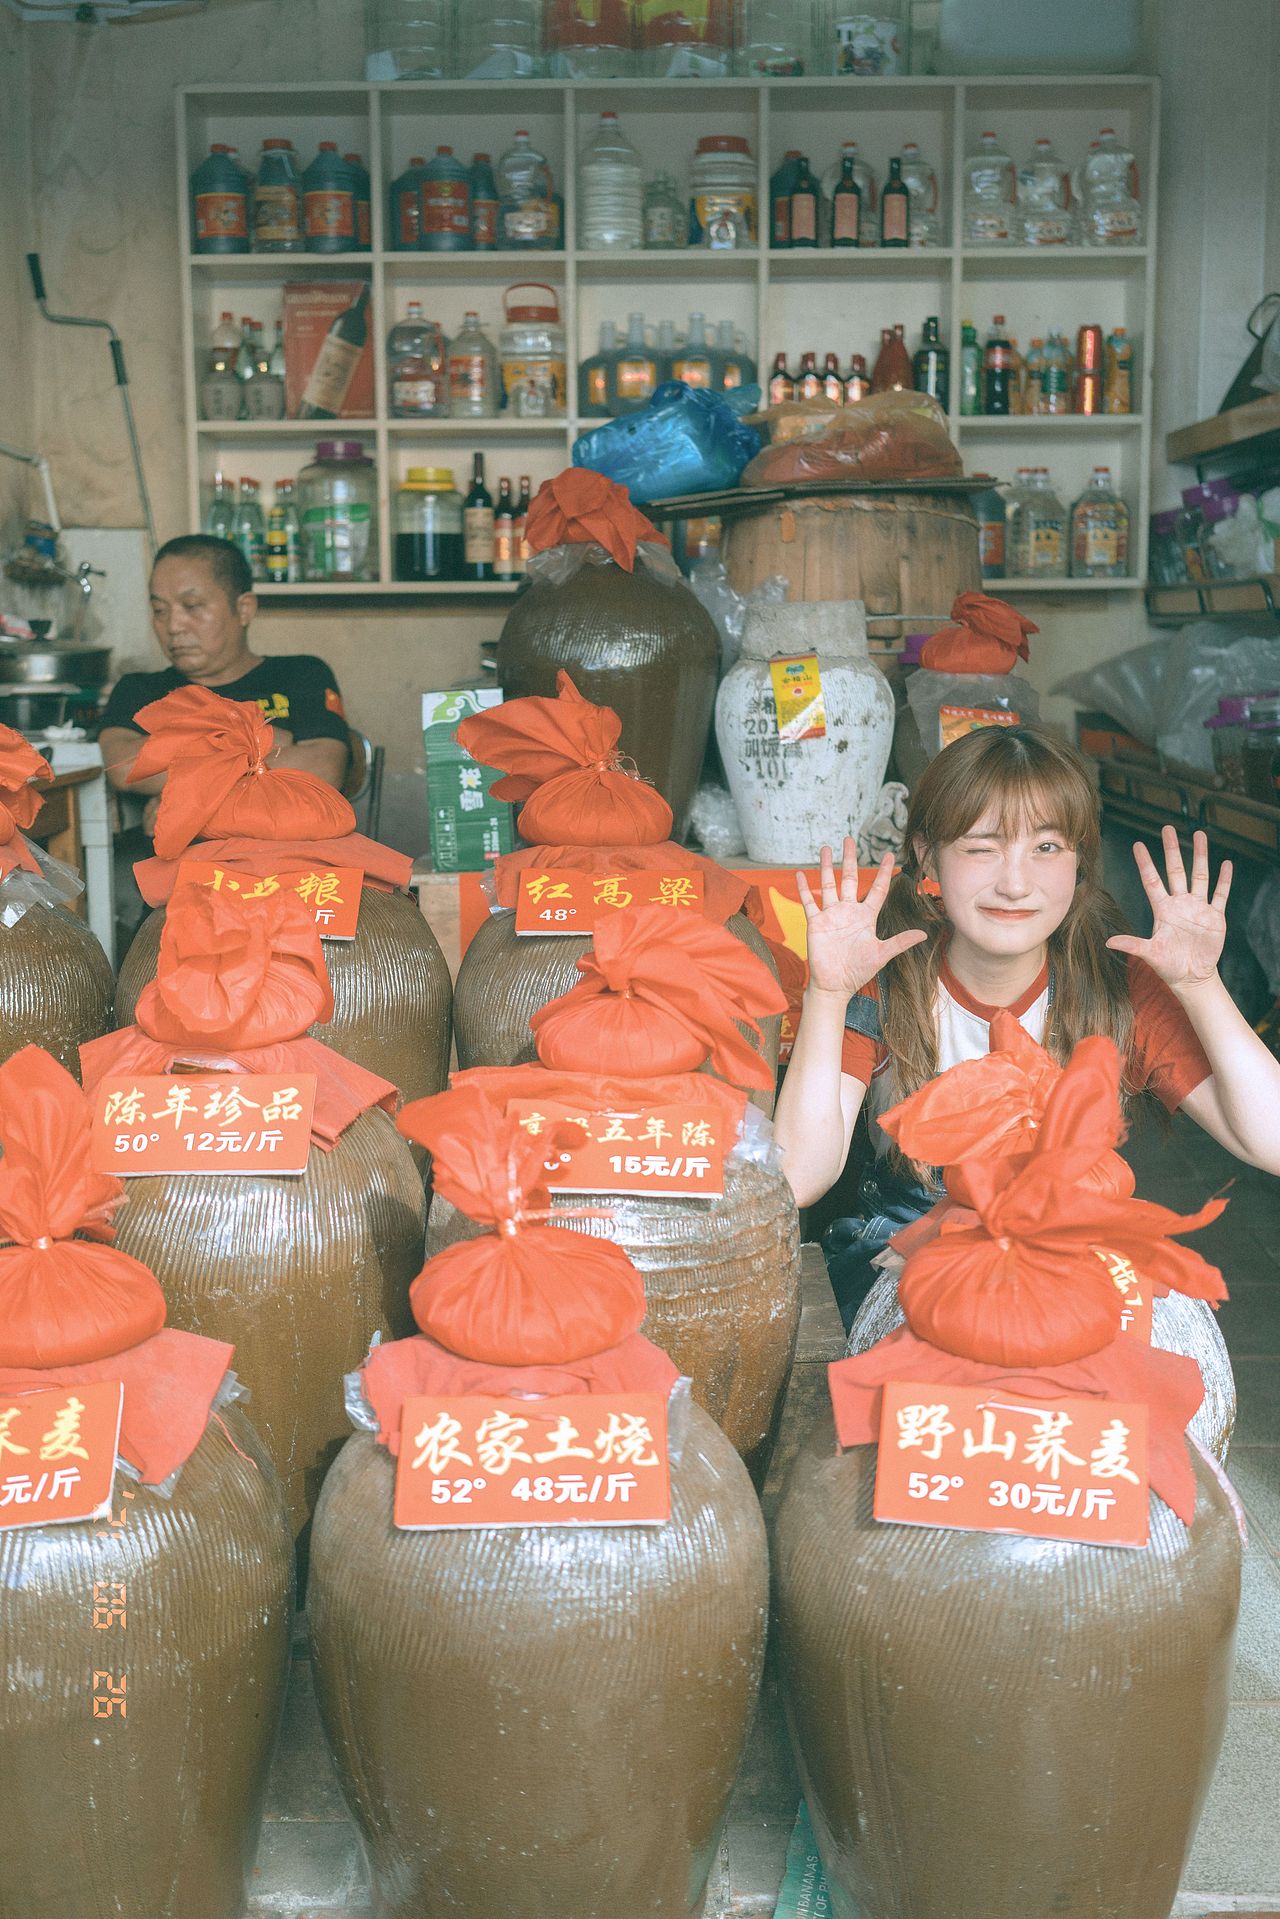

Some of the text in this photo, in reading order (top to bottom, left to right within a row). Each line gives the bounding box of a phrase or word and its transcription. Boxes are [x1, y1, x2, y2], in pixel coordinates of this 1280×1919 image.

[745, 719, 780, 735] 201
[539, 908, 577, 921] 48°
[103, 1083, 303, 1130] 陈年珍品
[114, 1129, 284, 1153] 50° 12元/斤
[608, 1155, 711, 1178] 15元/斤
[411, 1410, 660, 1476] 农家土烧
[896, 1404, 1141, 1485] 野山荞麦
[431, 1472, 638, 1504] 52° 48元/斤
[908, 1472, 1117, 1520] 52° 30元/斤
